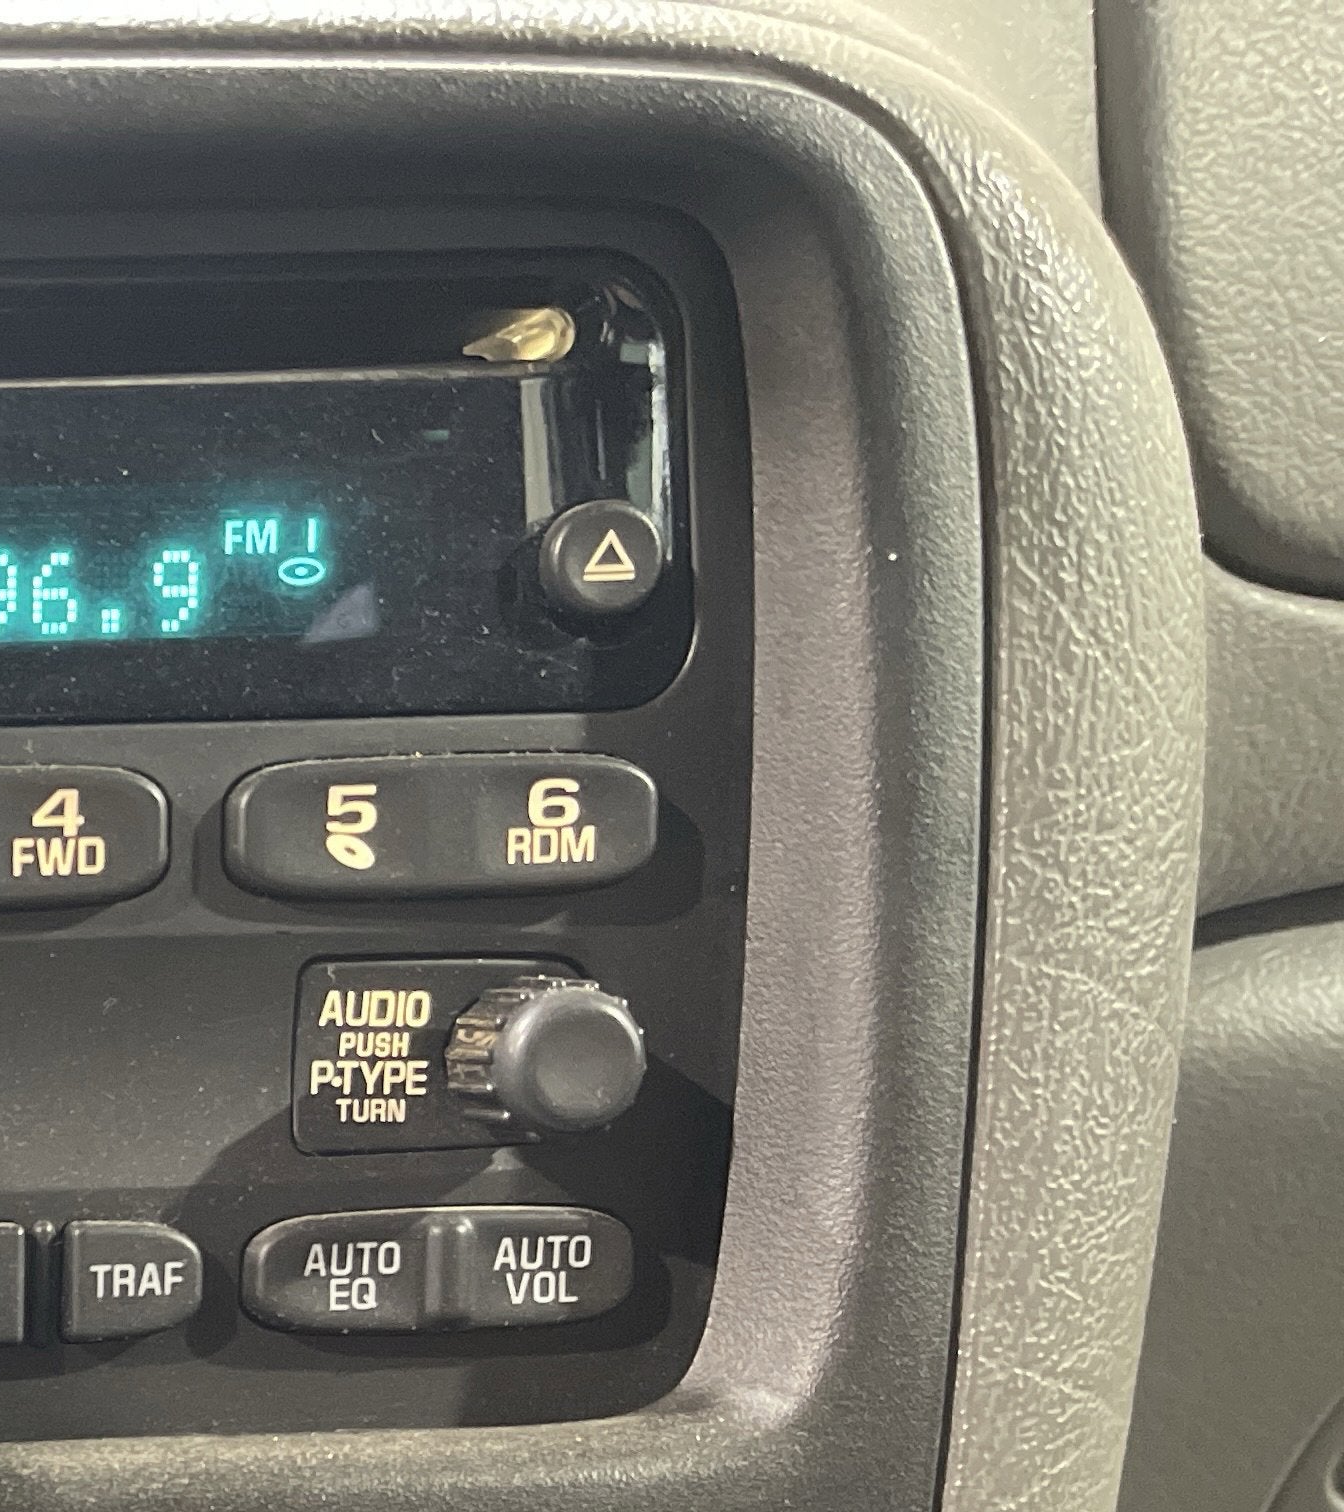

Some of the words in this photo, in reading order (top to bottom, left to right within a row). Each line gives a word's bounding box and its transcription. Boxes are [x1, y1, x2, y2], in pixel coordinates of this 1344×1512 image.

[224, 519, 278, 555] FM
[31, 788, 85, 837] 4
[325, 784, 378, 834] 5
[527, 778, 580, 828] 6
[12, 836, 105, 877] FWD
[507, 825, 595, 865] RDM
[318, 990, 432, 1028] AUDIO
[338, 1031, 410, 1058] PUSH
[335, 1098, 406, 1123] TURN
[304, 1241, 401, 1277] AUTO
[494, 1235, 592, 1272] AUTO
[89, 1262, 184, 1298] TRAF
[329, 1277, 378, 1311] EQ
[506, 1271, 579, 1305] VOL
